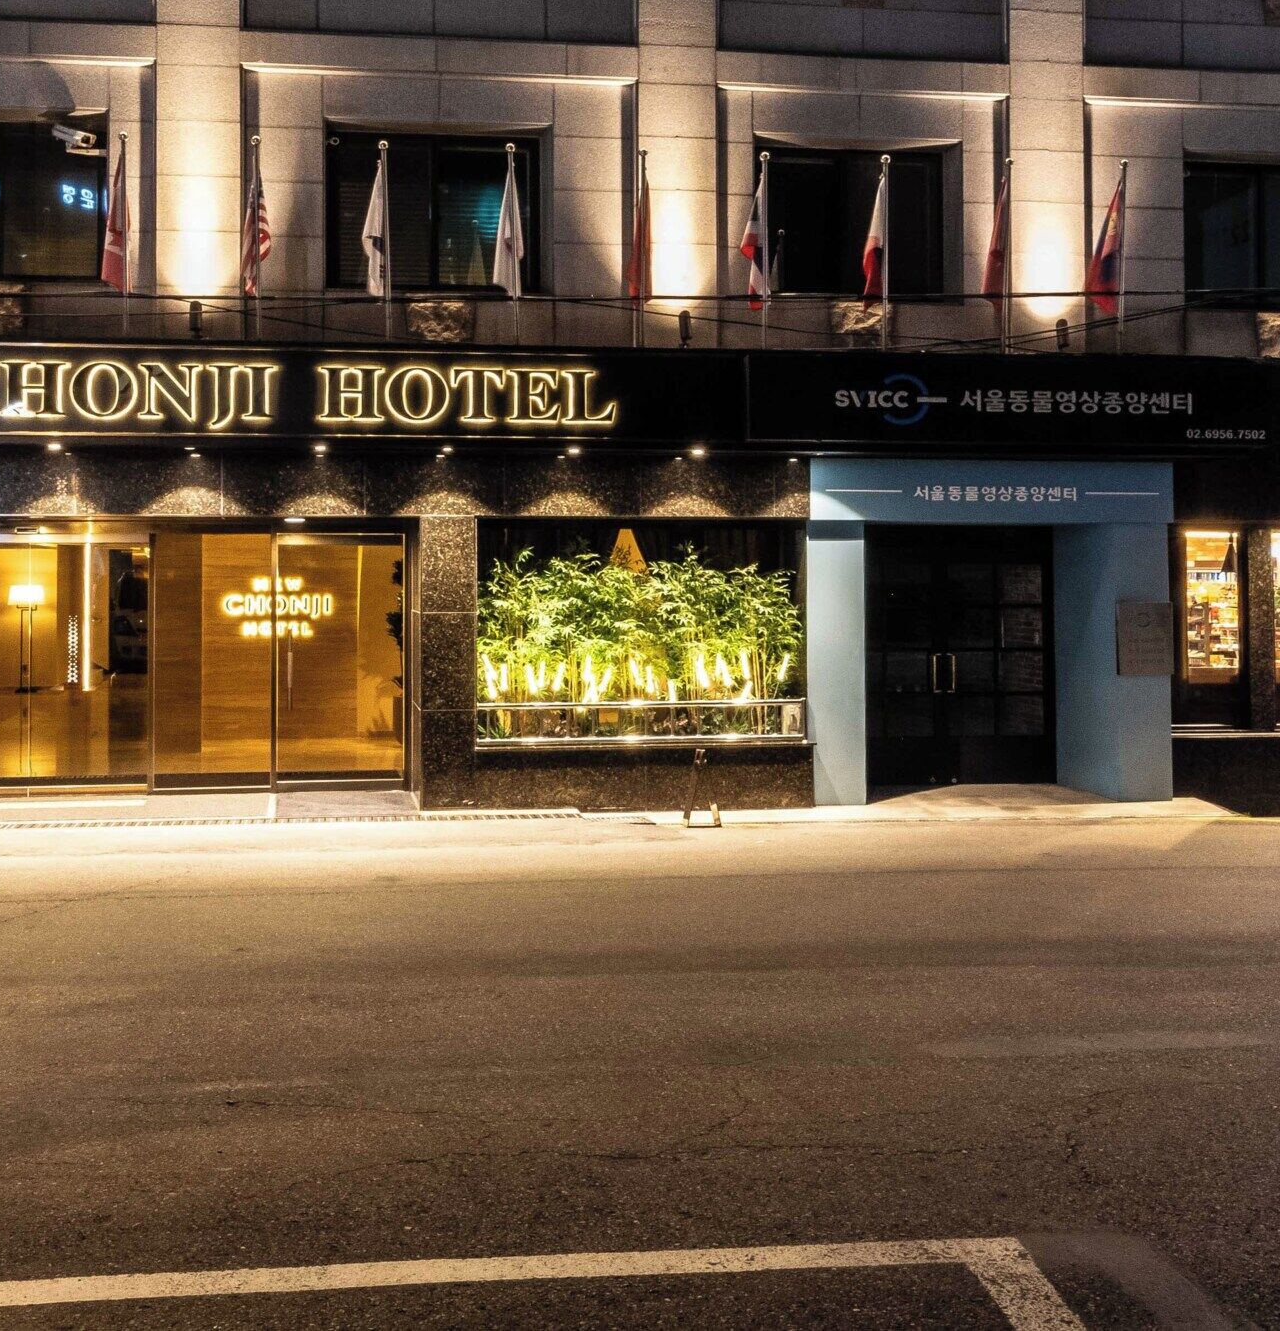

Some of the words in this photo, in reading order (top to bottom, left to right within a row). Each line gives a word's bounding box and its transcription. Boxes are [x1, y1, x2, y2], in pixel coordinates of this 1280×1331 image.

[317, 365, 618, 425] HOTEL
[960, 388, 1194, 416] 서울동물영상종양센터
[1186, 428, 1267, 441] 02.6956.7502
[913, 484, 1078, 503] 서울동물영상종양센터
[222, 592, 334, 621] CHONJI
